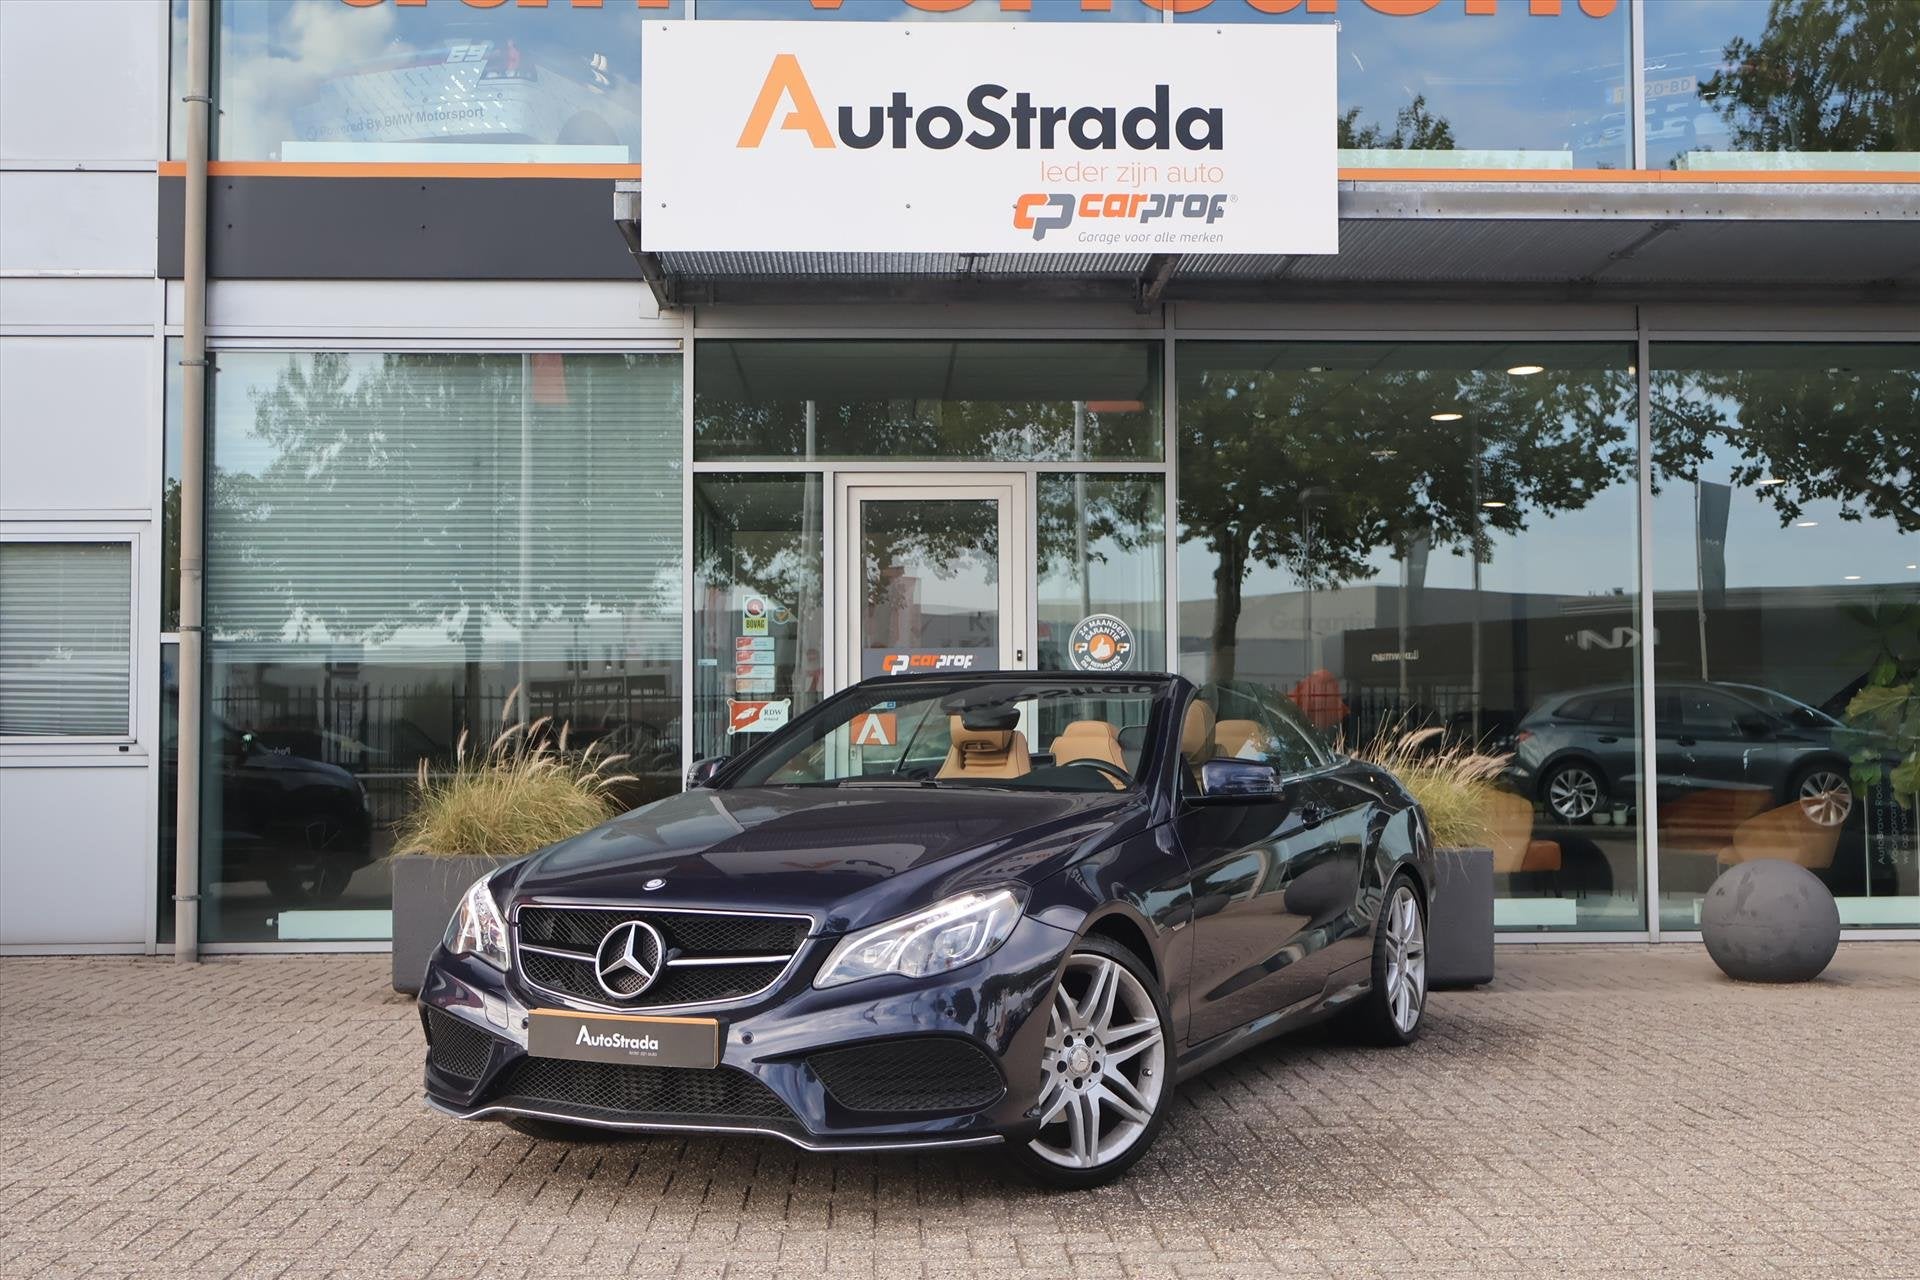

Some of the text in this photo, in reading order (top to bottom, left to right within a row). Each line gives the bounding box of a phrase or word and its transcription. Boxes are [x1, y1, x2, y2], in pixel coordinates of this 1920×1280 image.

[736, 54, 1224, 150] AutoStrada
[367, 118, 381, 131] By
[385, 113, 413, 127] BMW
[416, 107, 484, 123] Motorsport
[1041, 161, 1224, 188] Ieder zijn auto
[1078, 194, 1228, 224] carprof
[1078, 232, 1224, 244] Garage voor alle merken
[746, 619, 765, 629] BOVAG
[1079, 619, 1126, 637] 24 MAANDEN
[1085, 626, 1120, 641] GARANTIE
[910, 655, 974, 669] carprof
[576, 1025, 659, 1050] AutoStrada
